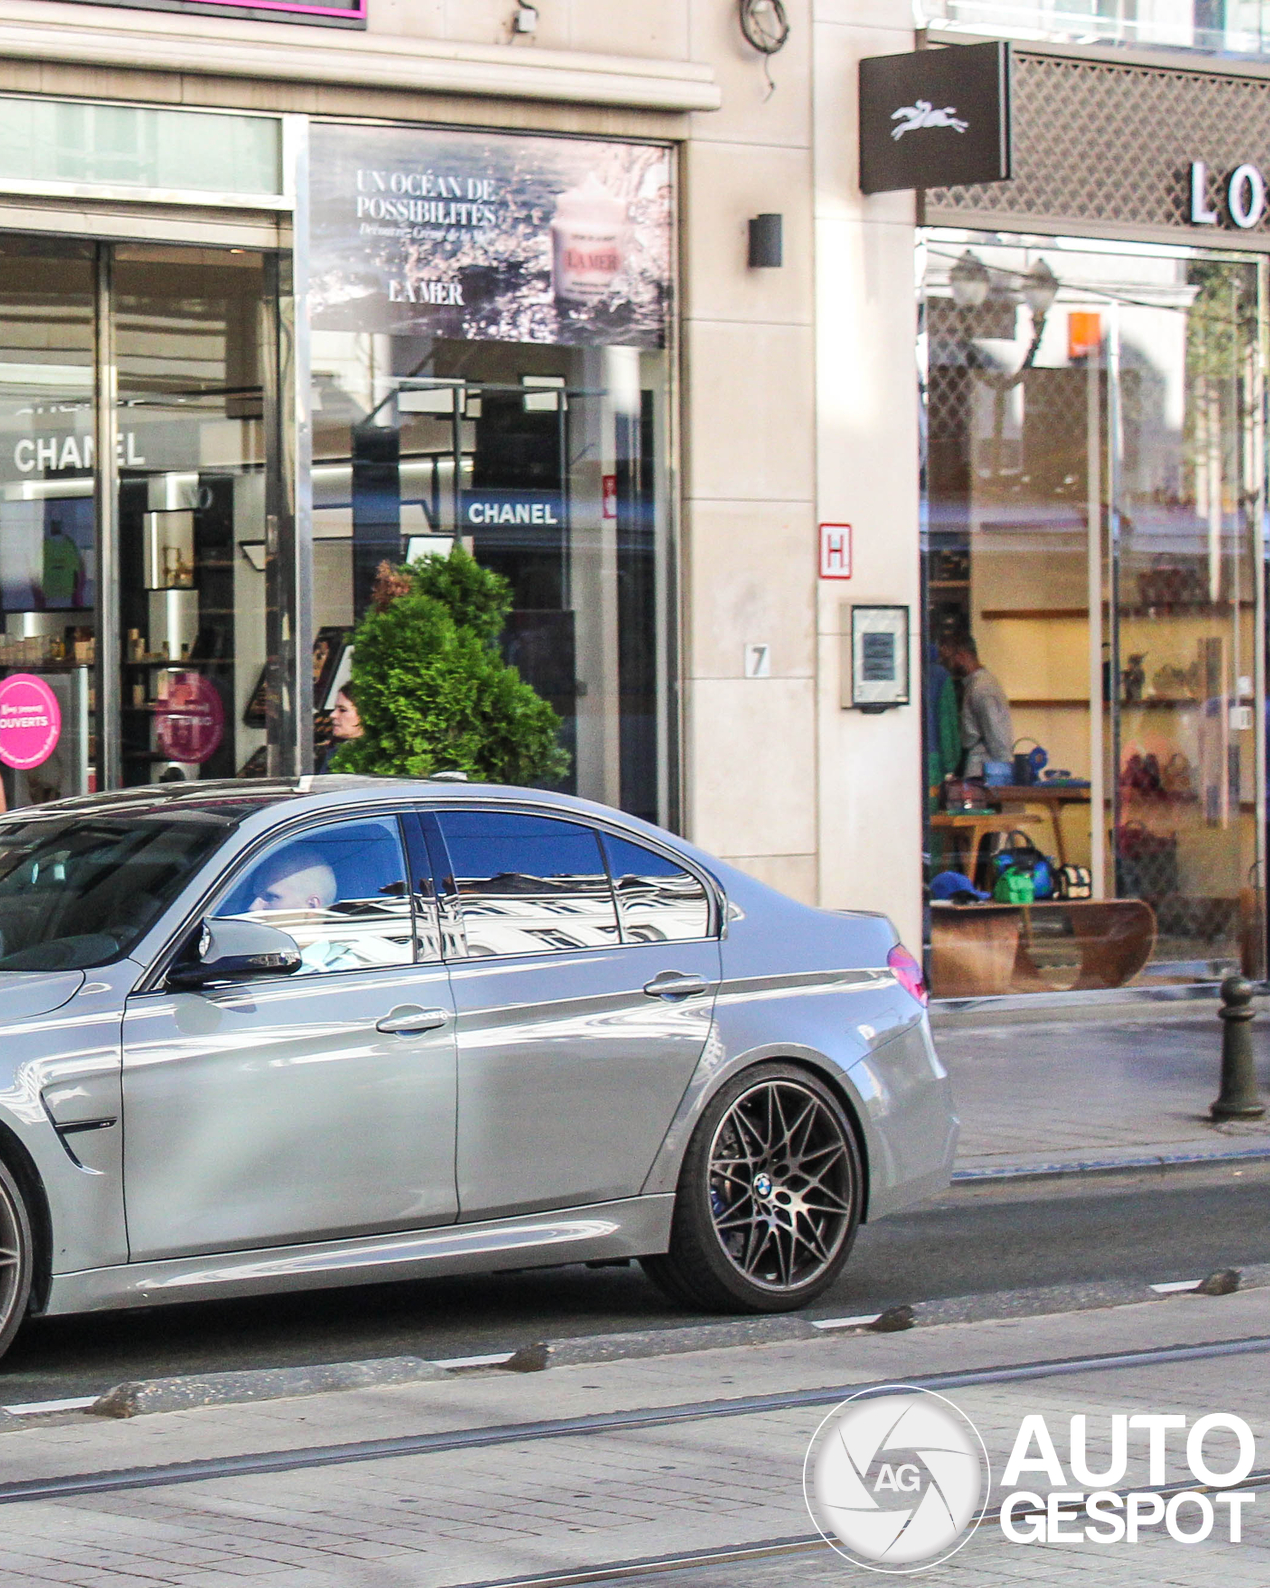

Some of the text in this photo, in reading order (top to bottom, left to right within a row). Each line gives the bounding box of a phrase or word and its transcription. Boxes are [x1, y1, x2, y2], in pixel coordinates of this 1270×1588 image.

[356, 168, 497, 202] UN OCÉAN DE
[1189, 161, 1265, 231] LO
[356, 196, 498, 227] POSSIBILITÉS
[388, 279, 466, 306] LA MER
[468, 502, 559, 525] CHANEL
[827, 534, 845, 569] H
[750, 646, 767, 676] 7
